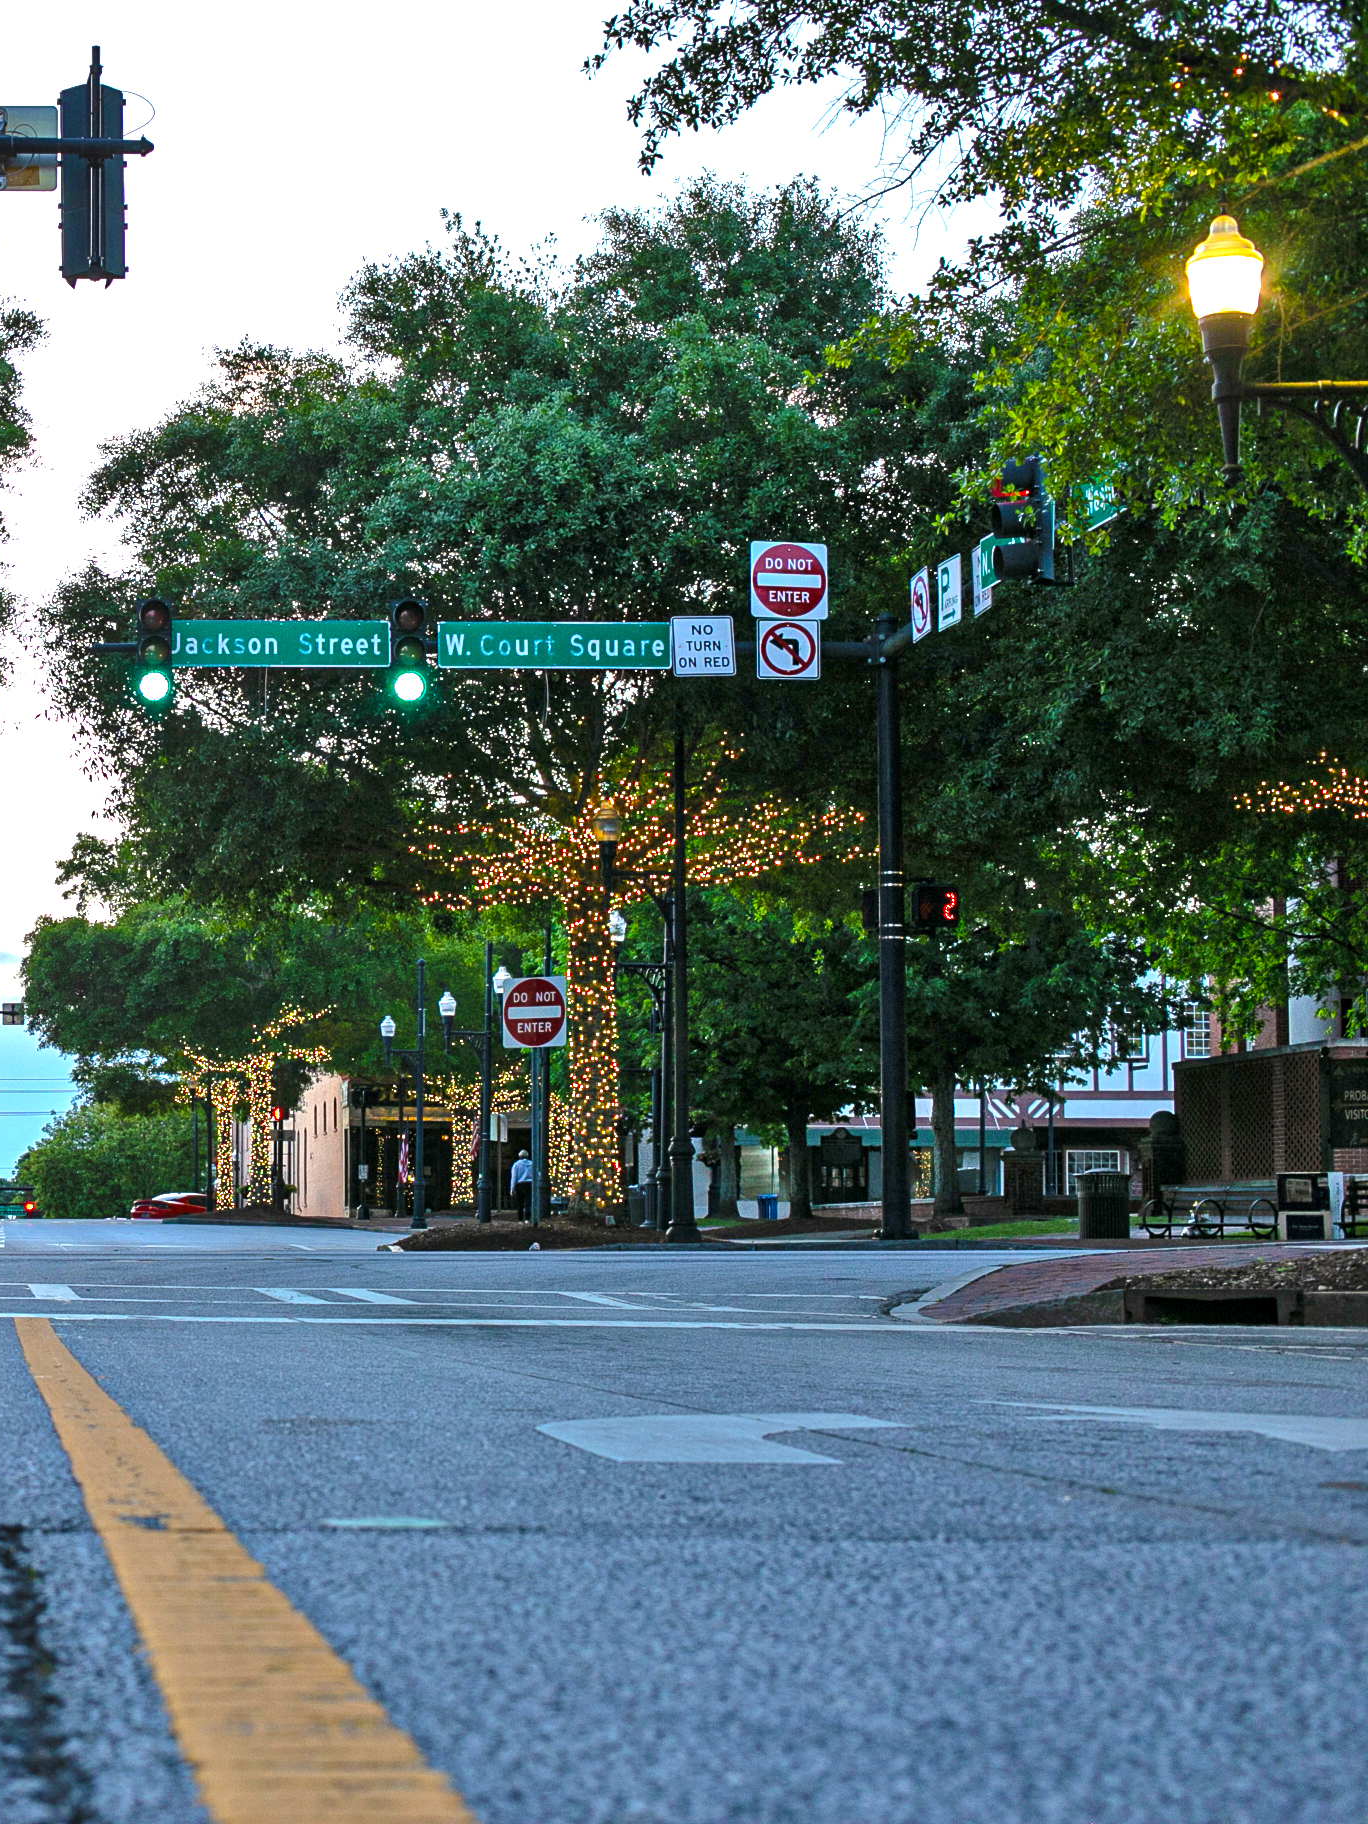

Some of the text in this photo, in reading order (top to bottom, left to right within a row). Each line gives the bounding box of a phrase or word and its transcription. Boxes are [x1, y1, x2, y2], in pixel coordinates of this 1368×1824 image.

[765, 557, 813, 571] DO NOT
[769, 590, 810, 603] ENTER
[691, 624, 713, 636] NO
[172, 632, 381, 656] Jackson Street
[445, 633, 665, 661] W. Court Square
[686, 640, 721, 652] TURN
[678, 656, 730, 668] ON RED
[943, 892, 957, 920] 2
[513, 991, 556, 1003] DO NOT
[517, 1022, 552, 1033] ENTER
[1344, 1090, 1368, 1101] PROB
